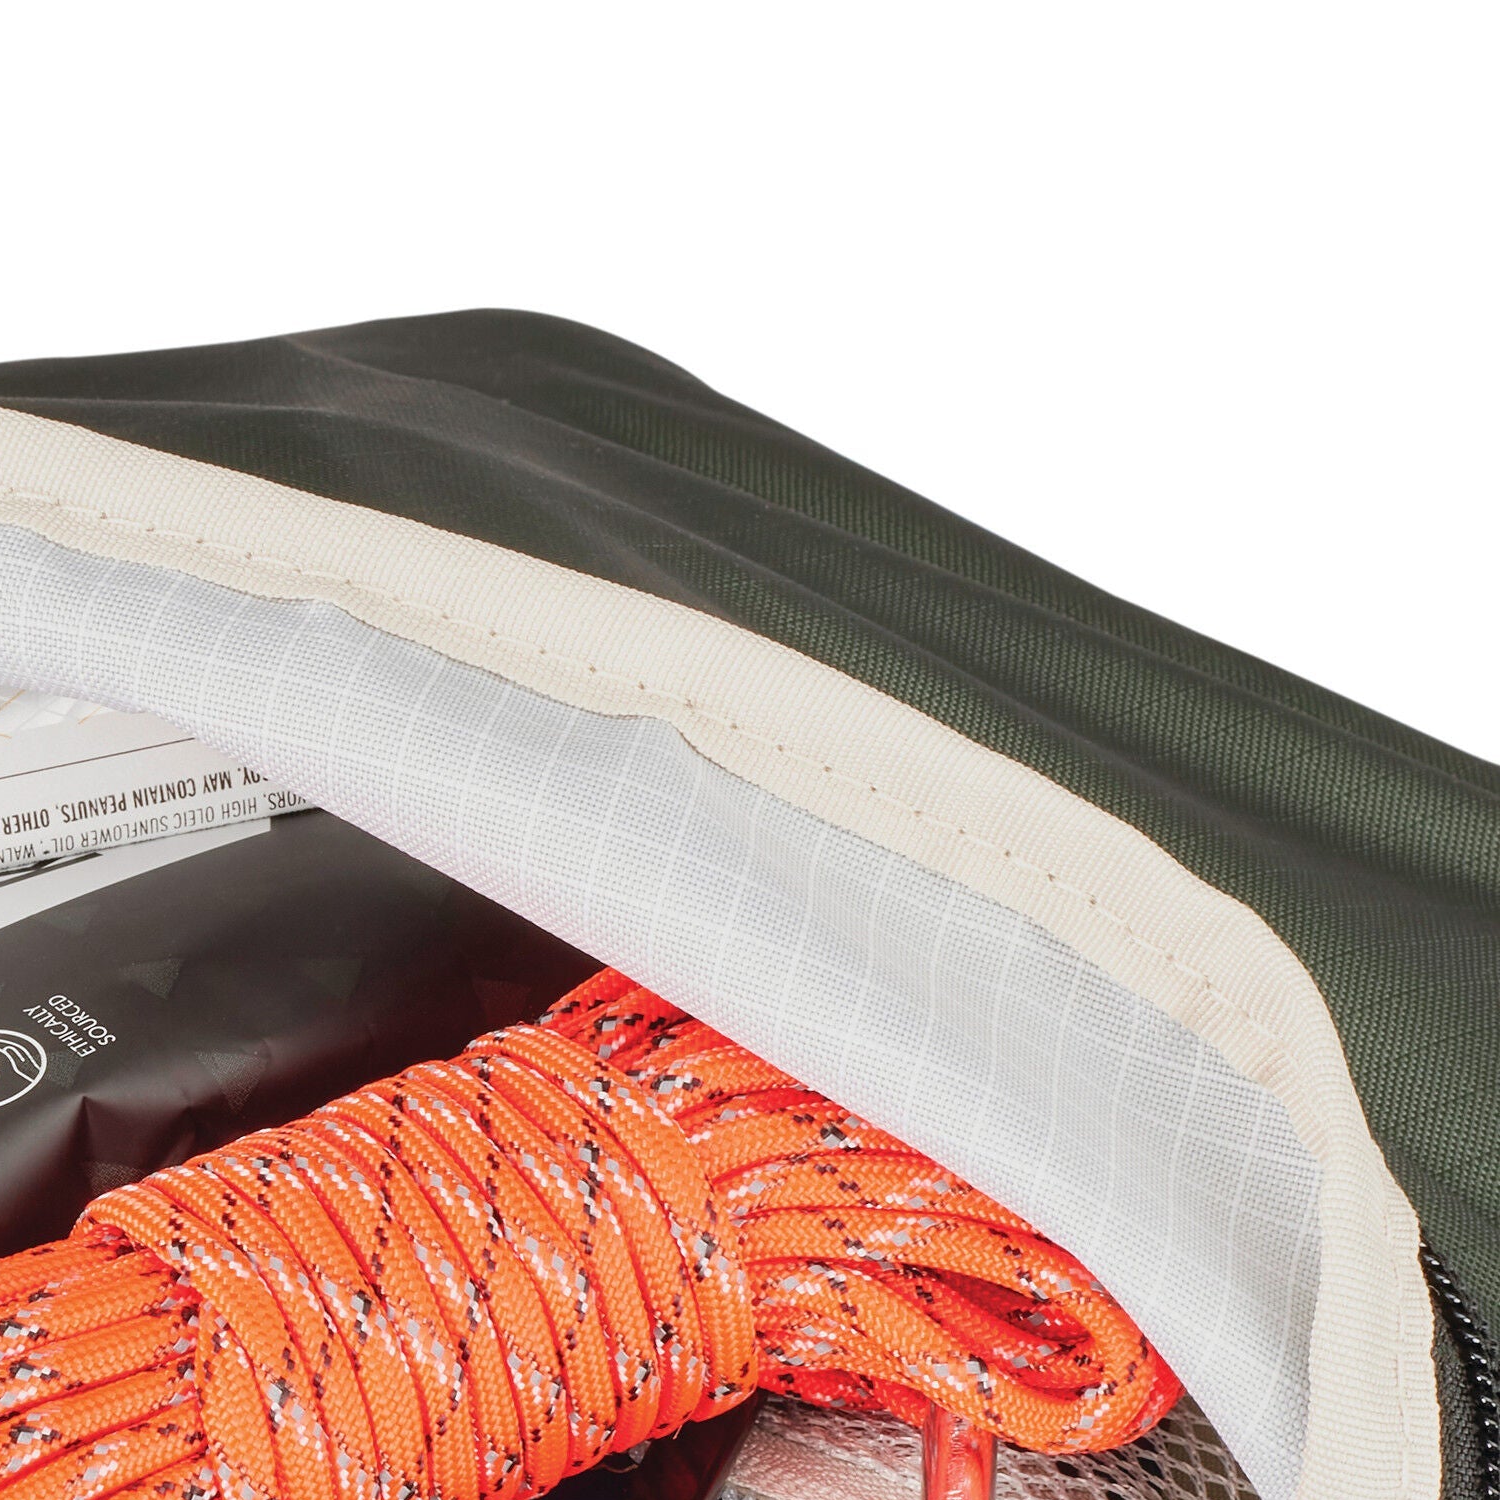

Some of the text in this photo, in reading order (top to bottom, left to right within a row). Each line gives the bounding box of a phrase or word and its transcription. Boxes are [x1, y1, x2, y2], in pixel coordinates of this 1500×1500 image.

[131, 777, 197, 808] CONTAIN
[201, 770, 232, 793] MAY
[1, 808, 50, 834] OTHER
[54, 792, 127, 823] PEANUTS,
[172, 805, 215, 829] OLEIC
[220, 796, 258, 820] HIGH
[78, 814, 169, 848] SUNFLOWER
[23, 1005, 96, 1057] ETHICALLY
[49, 995, 116, 1045] SOURCED
